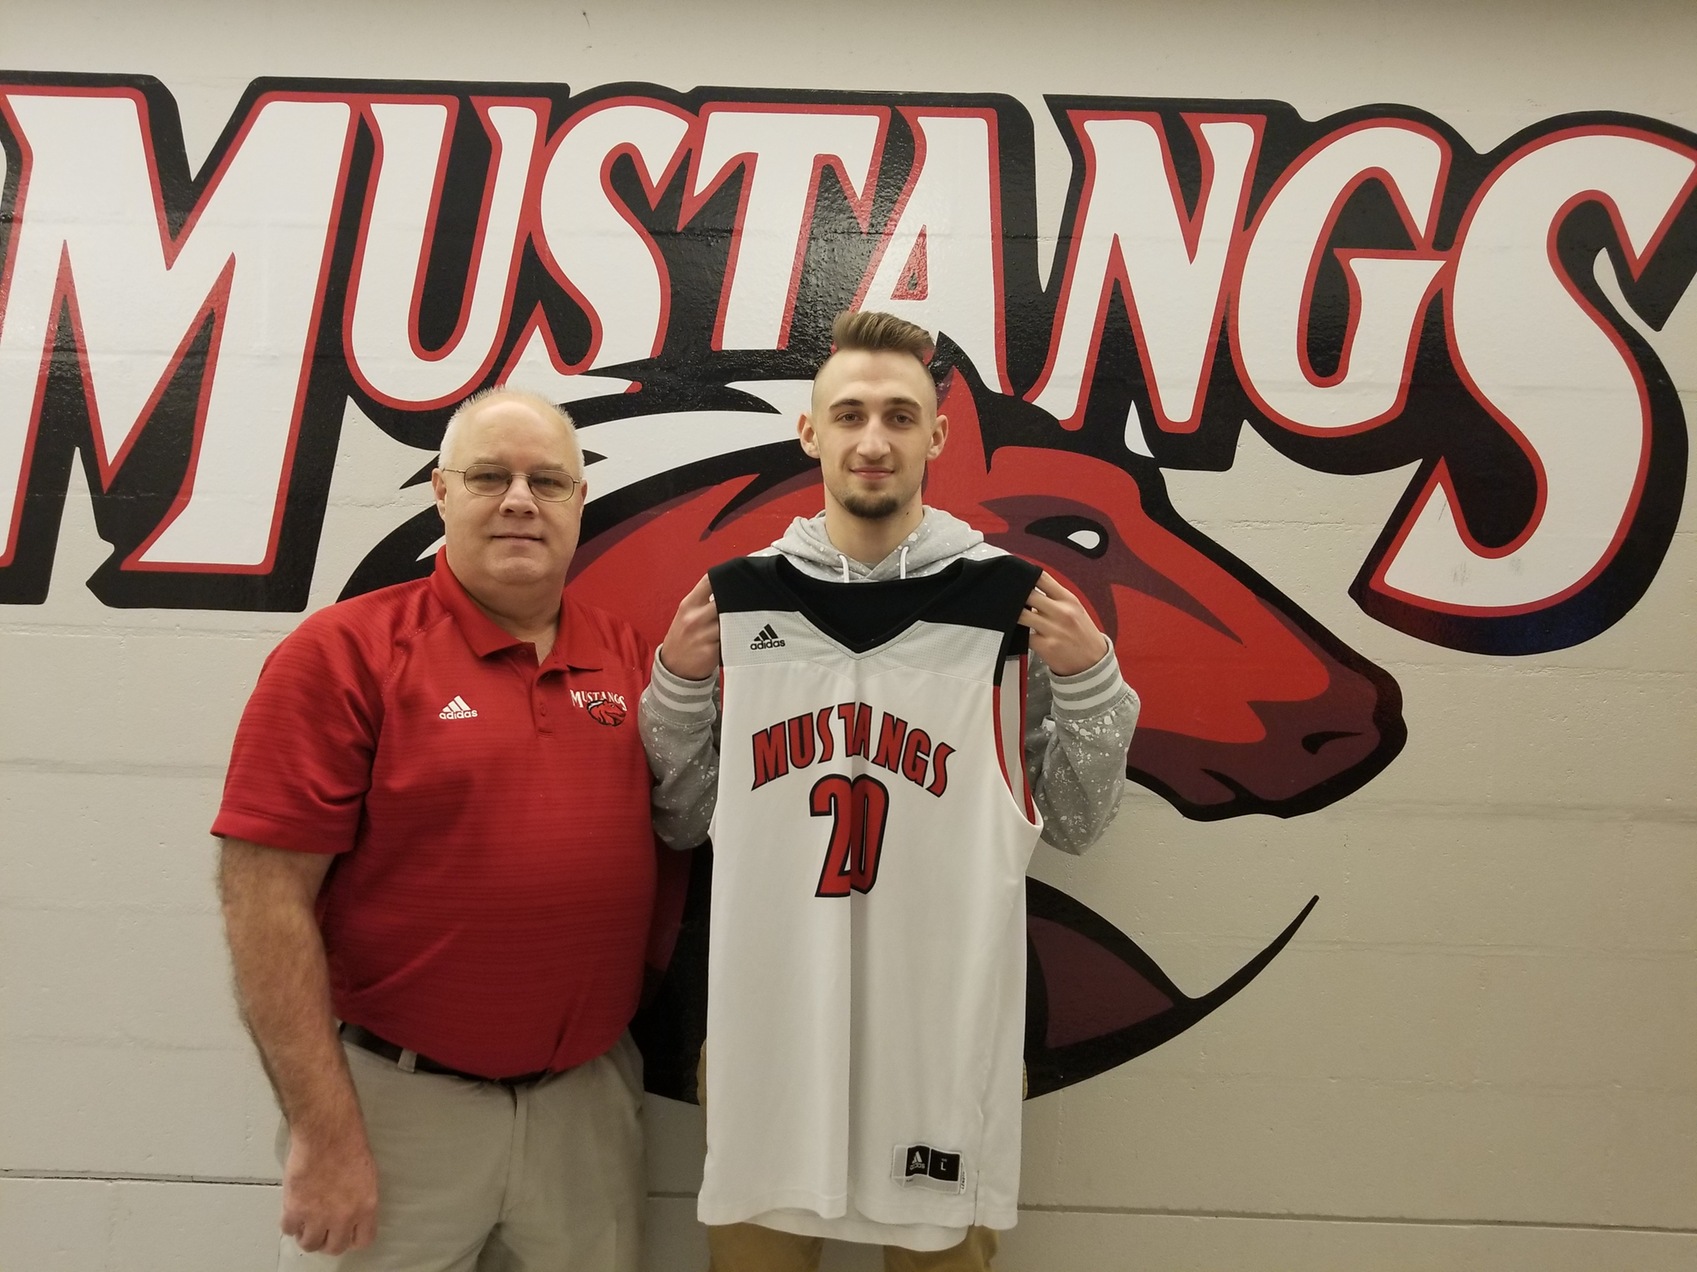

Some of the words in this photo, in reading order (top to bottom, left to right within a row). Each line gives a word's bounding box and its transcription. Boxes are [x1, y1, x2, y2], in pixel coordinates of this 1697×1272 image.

[0, 80, 1697, 630] MUSTANGS
[750, 638, 786, 650] adidas
[439, 708, 478, 720] adidas
[570, 689, 627, 711] MUSTANGS
[751, 702, 956, 798] MUSTANGS
[809, 773, 890, 897] 20
